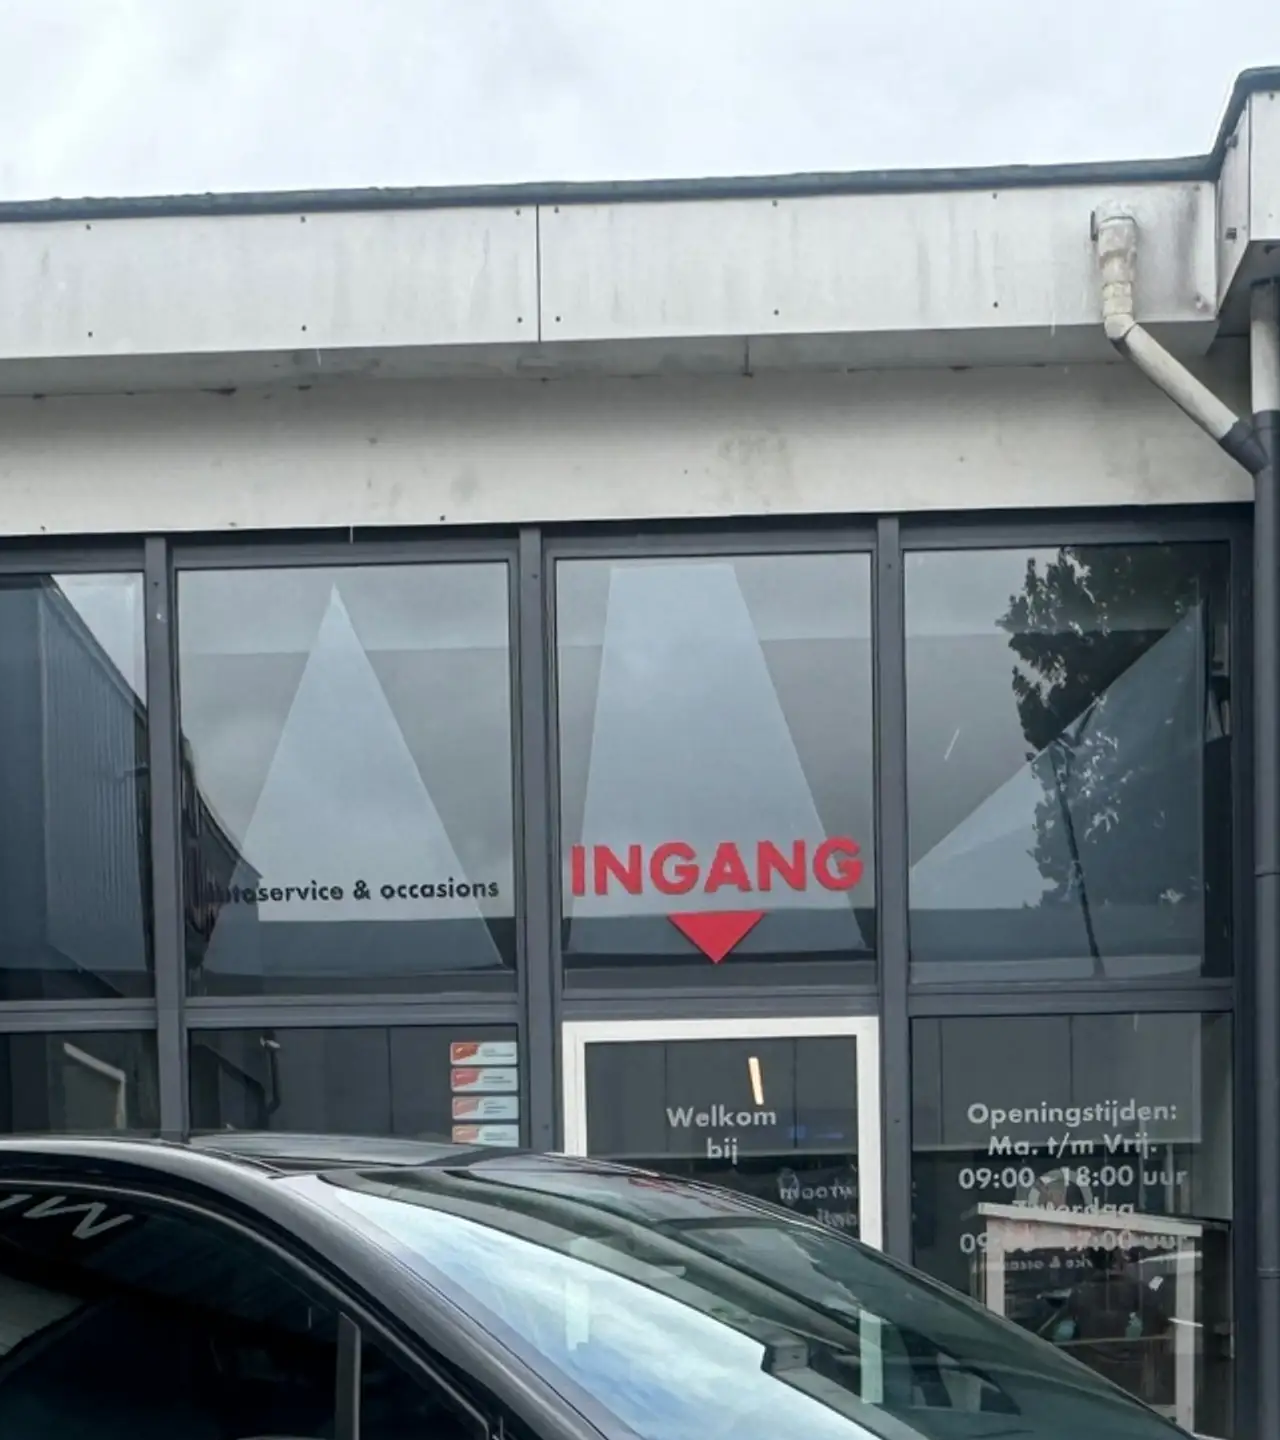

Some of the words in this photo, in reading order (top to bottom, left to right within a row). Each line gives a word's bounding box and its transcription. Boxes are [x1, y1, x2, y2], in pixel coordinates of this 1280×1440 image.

[570, 835, 864, 896] INGANG
[352, 879, 371, 900] &
[380, 877, 500, 900] occasions
[666, 1104, 777, 1128] Welkom
[967, 1098, 1178, 1130] Openingstijden:
[706, 1137, 739, 1166] bij
[988, 1135, 1038, 1156] Ma.
[1047, 1131, 1094, 1158] t/m
[1104, 1131, 1157, 1159] Vrij.
[958, 1166, 1036, 1189] 09:00
[1061, 1165, 1134, 1188] 18:00
[1143, 1168, 1189, 1186] uur
